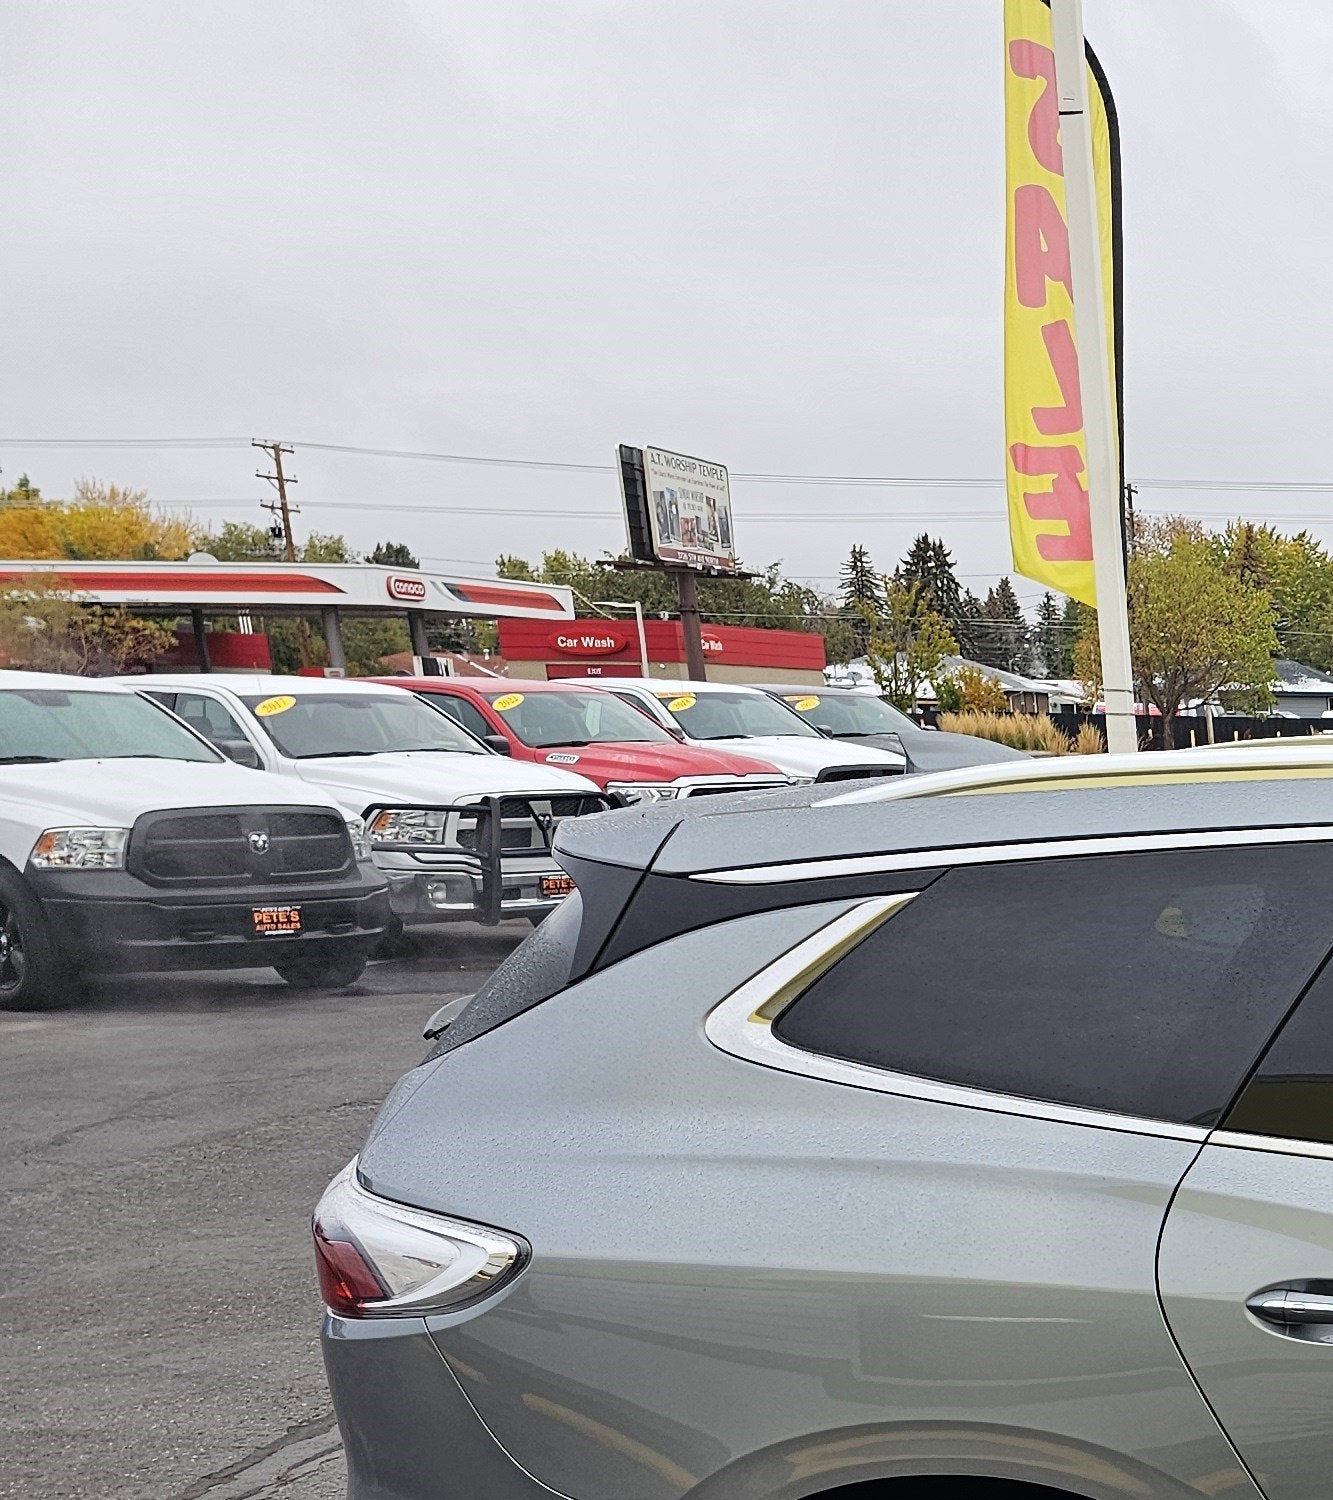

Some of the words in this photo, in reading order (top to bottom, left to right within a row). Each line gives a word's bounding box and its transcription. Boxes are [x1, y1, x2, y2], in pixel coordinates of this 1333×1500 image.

[664, 455, 697, 474] WORSHIP
[698, 464, 725, 482] TEMPLE
[557, 636, 578, 648] Car
[582, 636, 615, 648] Wash
[253, 911, 300, 923] PETE'S
